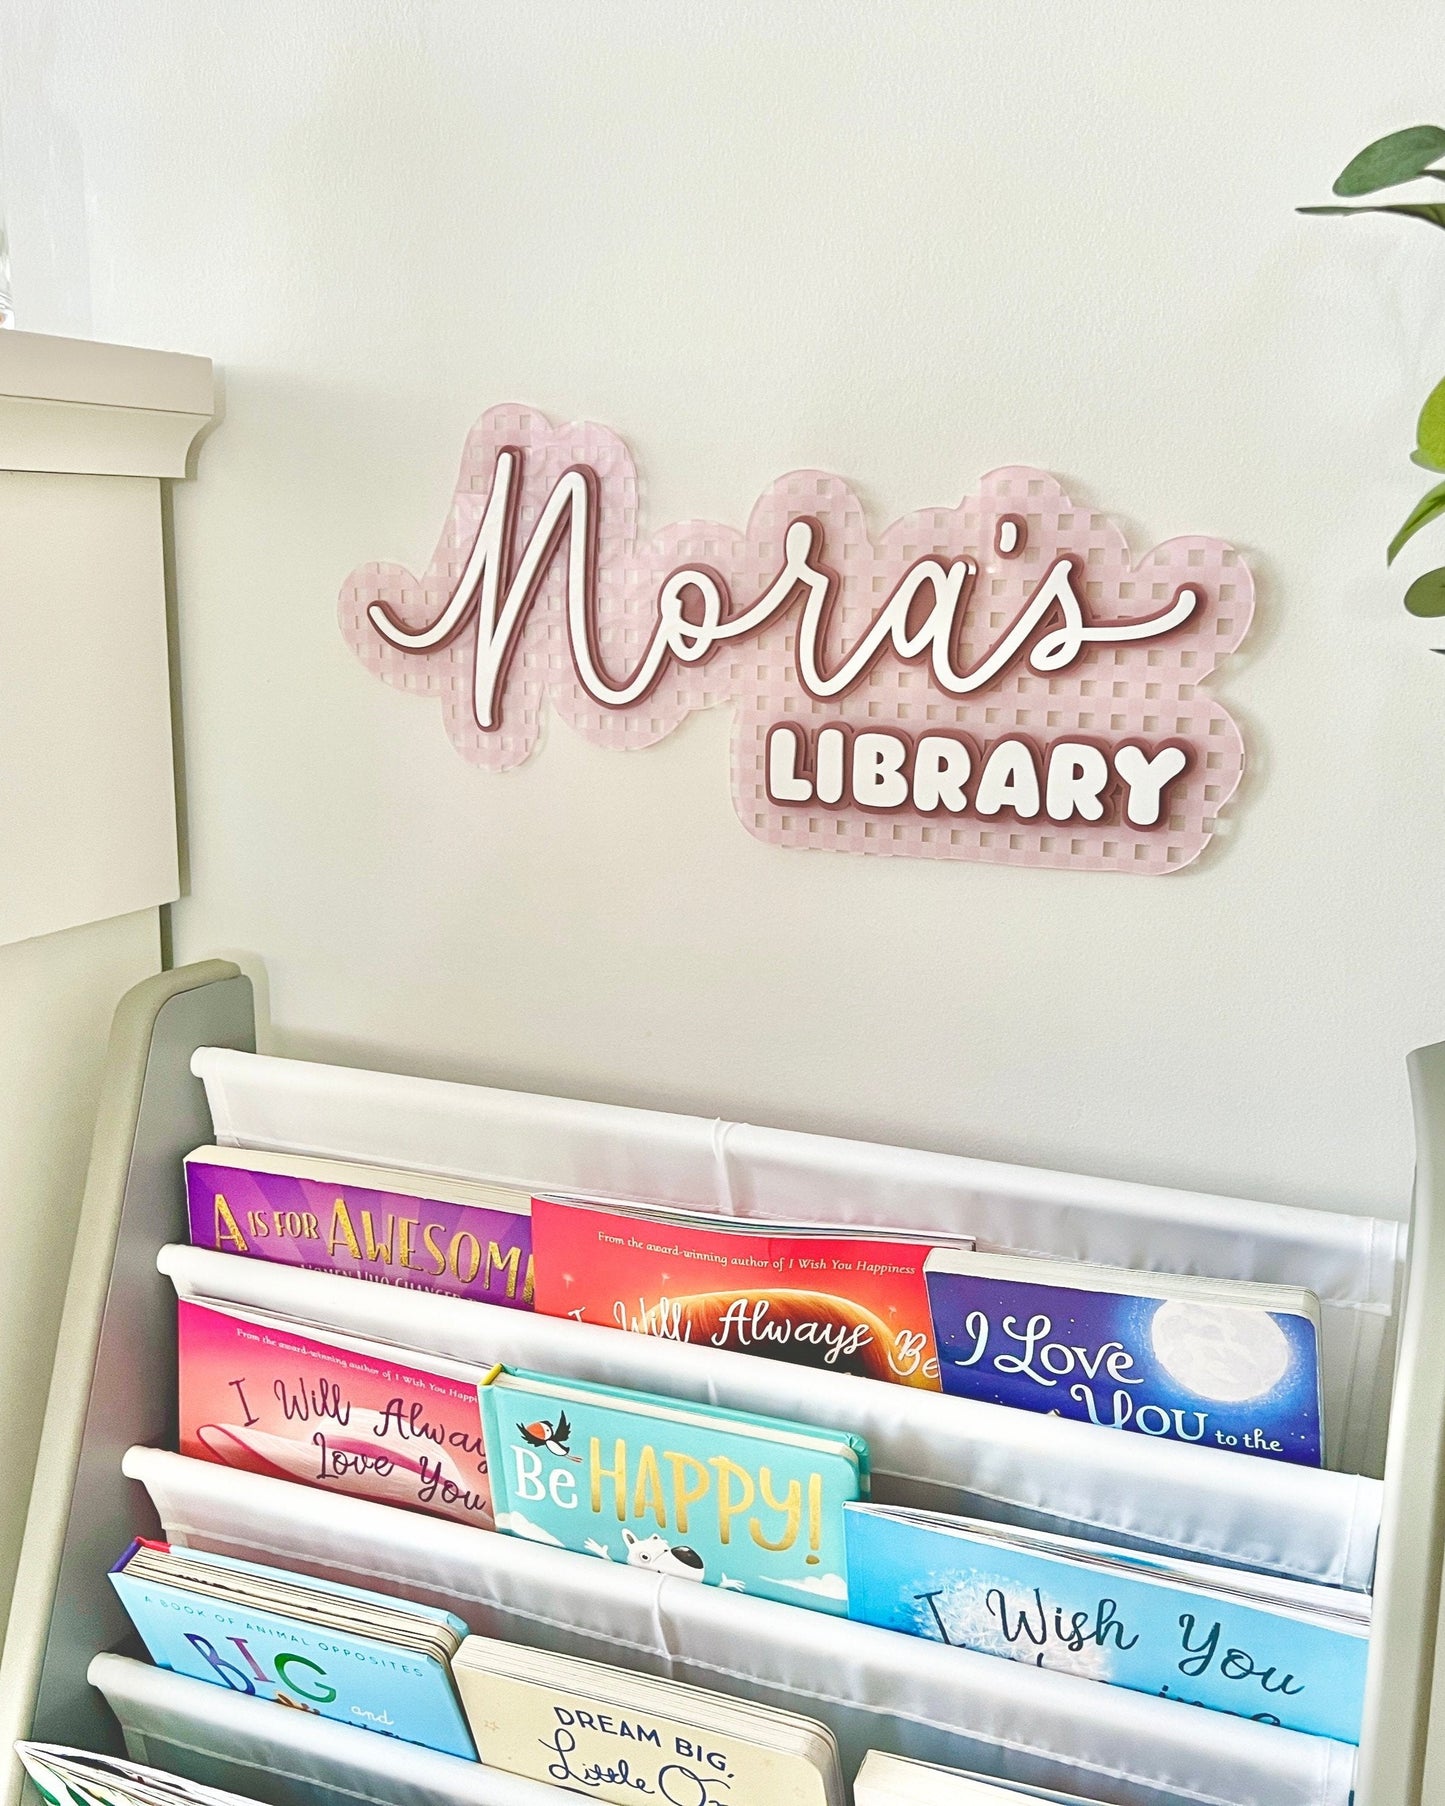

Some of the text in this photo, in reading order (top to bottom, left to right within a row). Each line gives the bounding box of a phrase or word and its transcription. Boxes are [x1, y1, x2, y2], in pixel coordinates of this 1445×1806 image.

[367, 447, 1200, 730] Nora's
[767, 724, 1190, 829] LIBRARY
[215, 1193, 249, 1251] A
[247, 1210, 269, 1237] IS
[273, 1211, 319, 1239] FOR
[598, 1231, 917, 1276] From the award-winning author of I Wish You Happiness
[236, 1328, 261, 1342] From
[262, 1336, 277, 1347] the
[278, 1342, 348, 1368] award-winning
[348, 1361, 379, 1376] author
[382, 1370, 392, 1381] of
[402, 1375, 426, 1389] Wish
[428, 1383, 447, 1395] You
[711, 1298, 874, 1365] Always
[887, 1329, 940, 1379] Be
[955, 1310, 1145, 1387] I Love
[228, 1377, 260, 1417] I
[273, 1377, 351, 1426] Will
[313, 1431, 487, 1511] Love You
[1214, 1429, 1238, 1446] to
[1242, 1428, 1284, 1452] the
[510, 1436, 823, 1566] Be HAPPY!
[183, 1632, 337, 1703] BIG
[246, 1622, 310, 1646] ANIMAL
[318, 1642, 423, 1677] OPPOSITES
[913, 1589, 966, 1649] I
[985, 1587, 1139, 1653] Wish
[1177, 1612, 1305, 1695] You
[351, 1704, 395, 1726] and
[553, 1706, 661, 1748] DREAM
[538, 1729, 655, 1794] Little
